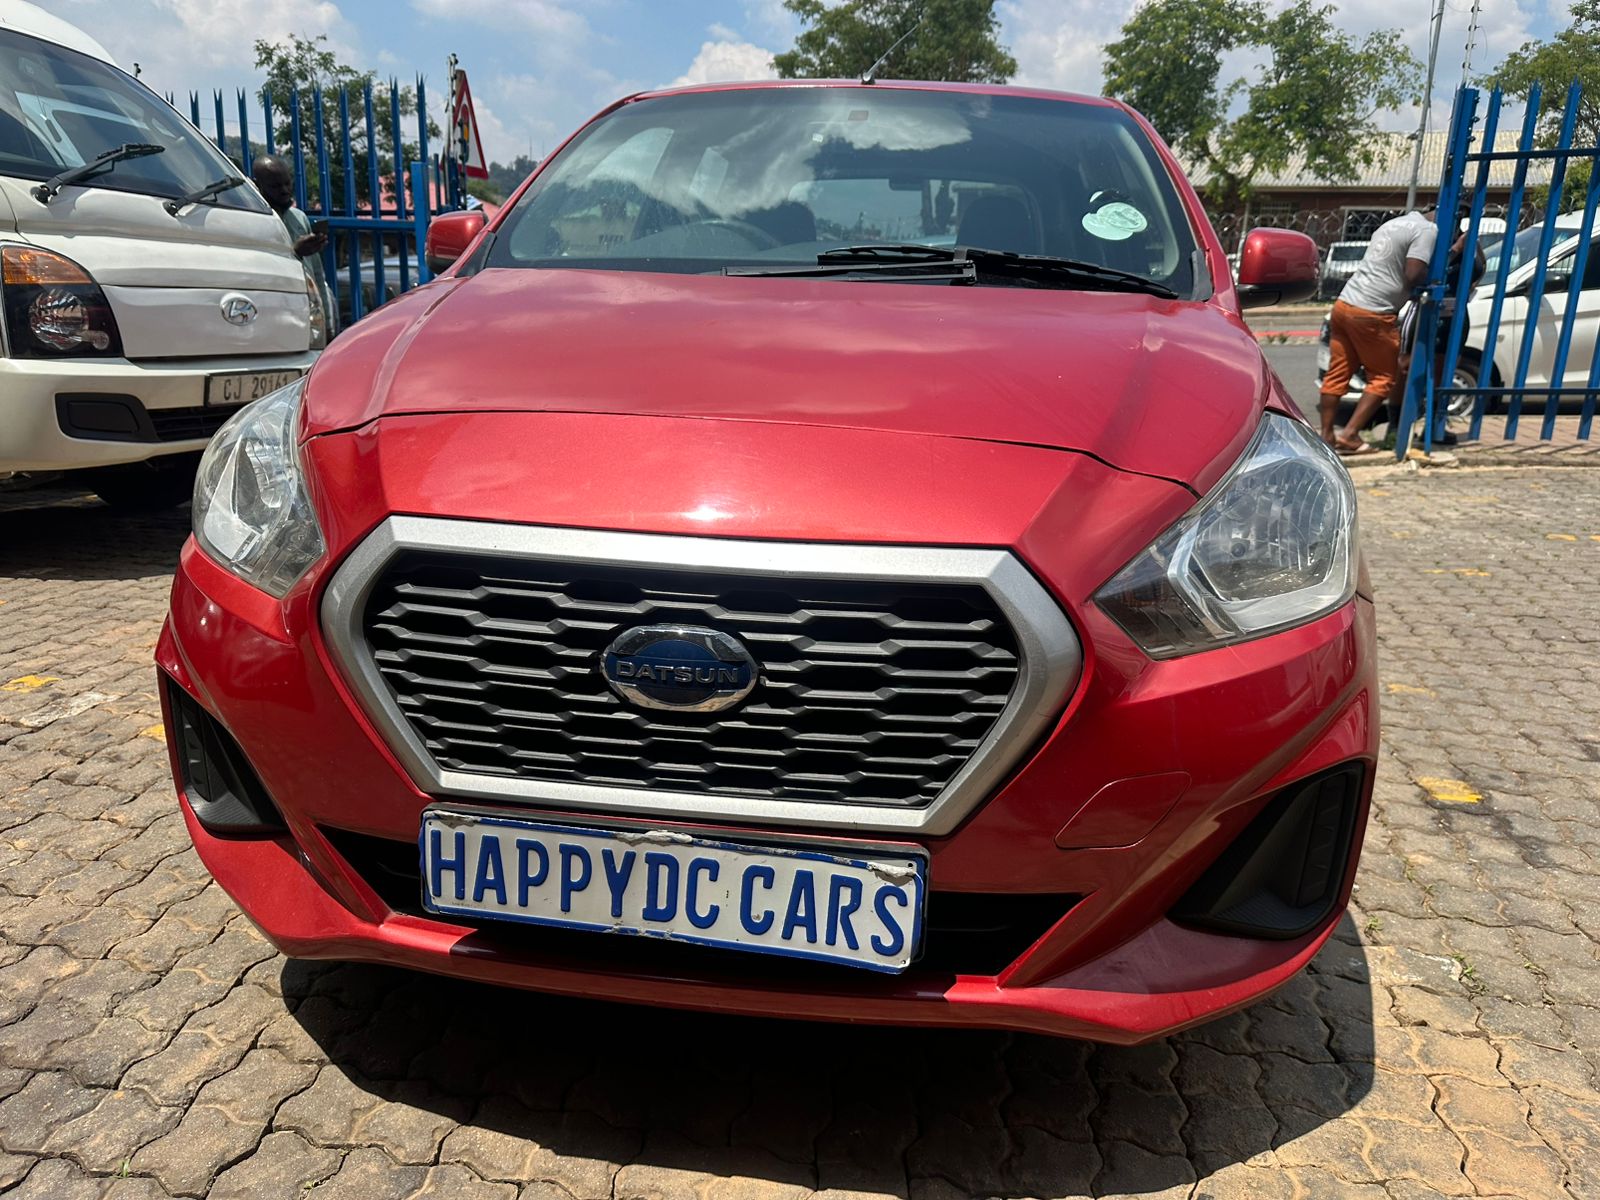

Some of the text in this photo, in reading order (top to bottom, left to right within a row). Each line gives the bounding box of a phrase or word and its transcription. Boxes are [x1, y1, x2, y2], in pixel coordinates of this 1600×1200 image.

[223, 377, 242, 400] CJ
[615, 660, 739, 684] DATSUN
[430, 829, 908, 957] HAPPYDC CARS
